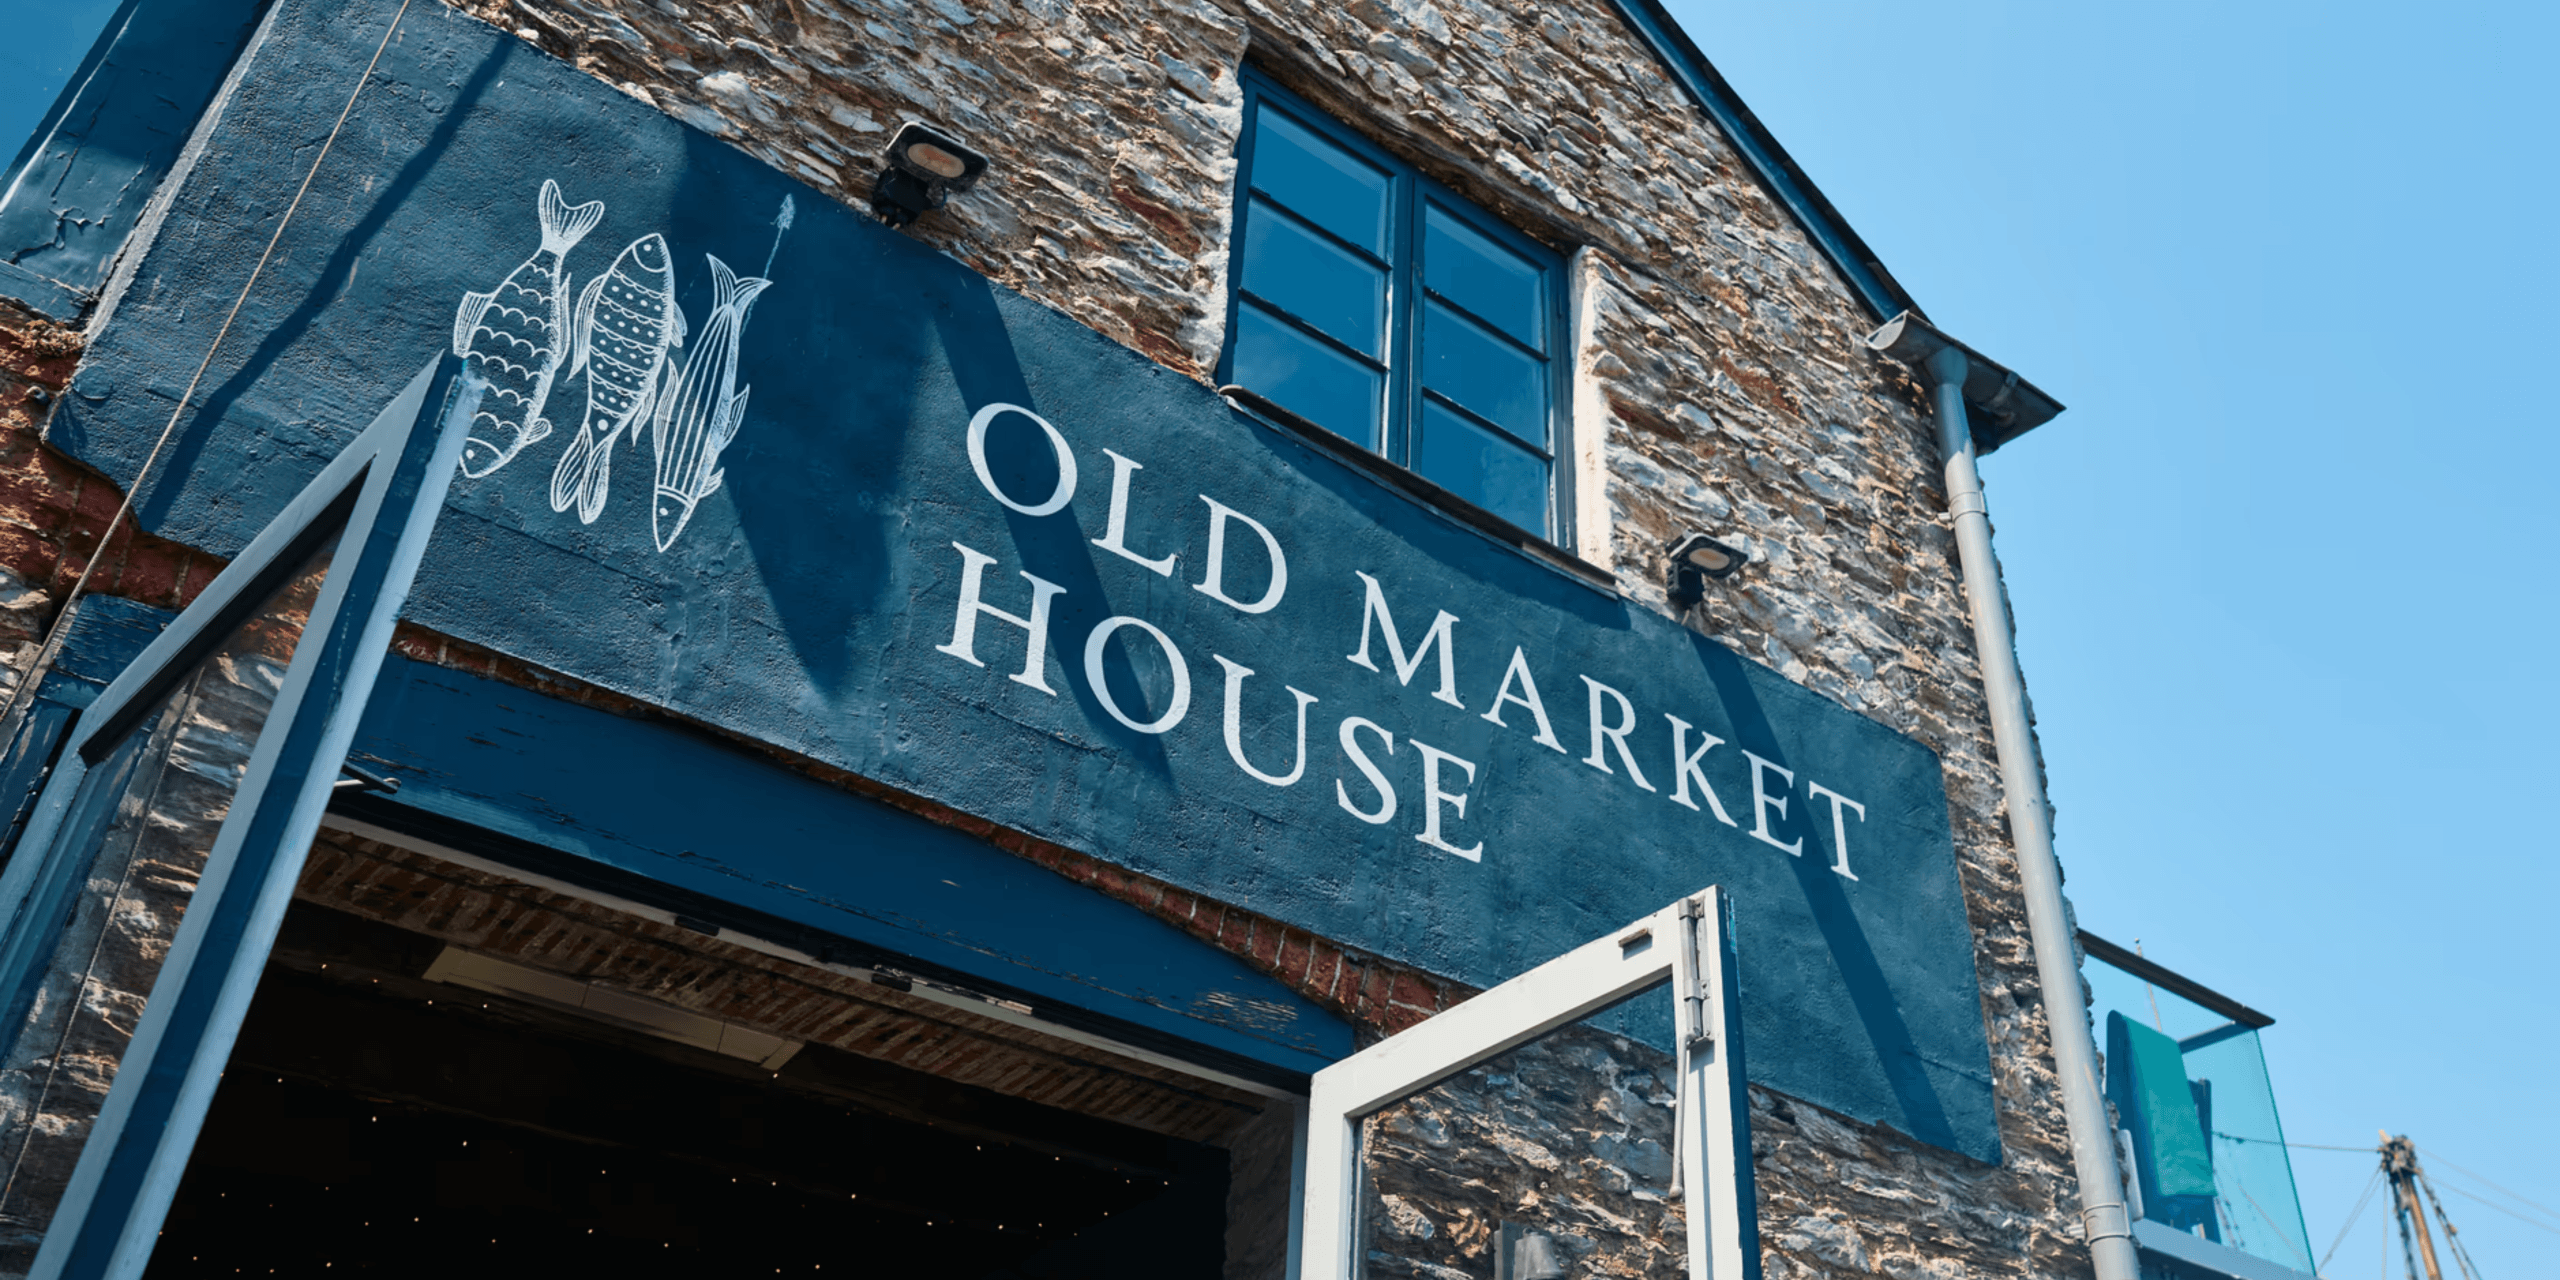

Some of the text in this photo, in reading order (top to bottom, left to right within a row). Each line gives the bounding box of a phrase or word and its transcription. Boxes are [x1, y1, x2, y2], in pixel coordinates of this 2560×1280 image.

[935, 540, 1483, 863] HOUSE
[966, 403, 1865, 882] OLD MARKET
